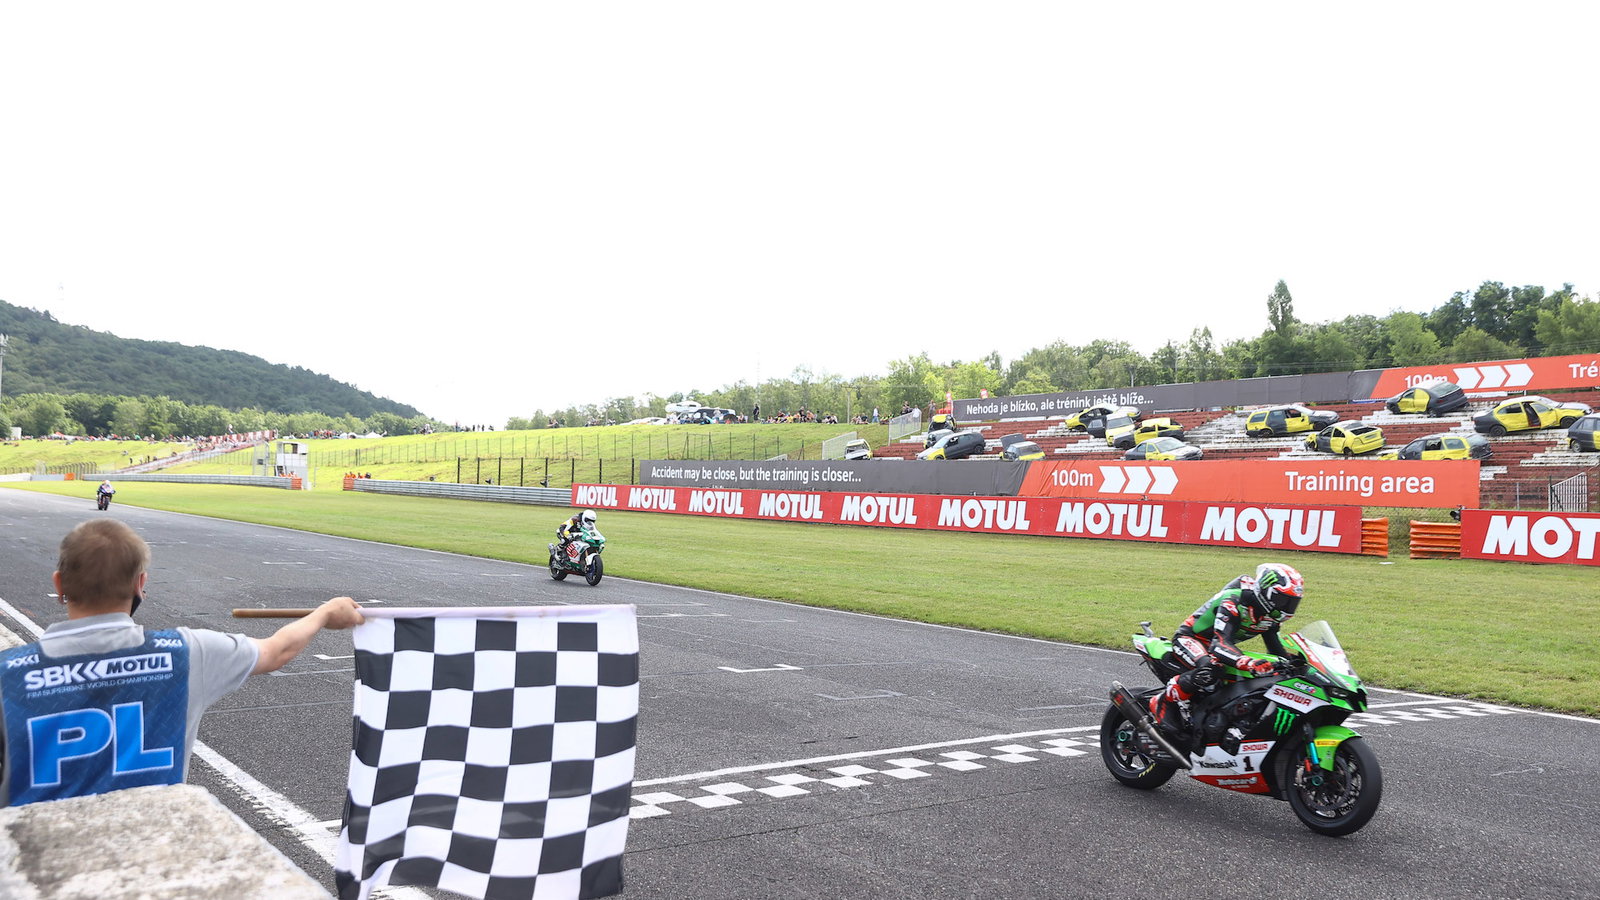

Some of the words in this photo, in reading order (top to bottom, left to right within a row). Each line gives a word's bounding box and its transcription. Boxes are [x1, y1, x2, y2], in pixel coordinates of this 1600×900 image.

[1568, 360, 1599, 379] Tré
[966, 402, 999, 415] Nehoda
[999, 402, 1009, 415] je
[1010, 400, 1039, 413] blízko,
[1040, 399, 1055, 411] ale
[1056, 396, 1091, 409] trénink
[651, 466, 683, 479] Accident
[684, 468, 701, 482] may
[702, 466, 712, 480] be
[713, 466, 738, 482] close,
[740, 467, 754, 481] but
[756, 466, 771, 481] the
[772, 467, 809, 484] training
[811, 467, 820, 482] is
[821, 466, 862, 483] closer...
[1051, 469, 1094, 487] 100m
[1285, 470, 1374, 497] Training
[1381, 476, 1434, 494] area
[575, 485, 618, 507] MOTUL
[628, 487, 677, 511] MOTUL
[688, 490, 744, 515] MOTUL
[758, 492, 824, 519] MOTUL
[840, 495, 917, 525] MOTUL
[937, 498, 1030, 530] MOTUL
[1055, 502, 1169, 538] MOTUL
[1200, 506, 1341, 547] MOTUL
[1481, 515, 1600, 560] MOT
[24, 662, 86, 690] SBK
[105, 655, 170, 675] MOTUL
[1273, 687, 1313, 707] SHOWA
[27, 701, 175, 789] PL
[1199, 759, 1238, 769] Kawasaki
[1243, 756, 1255, 772] 1
